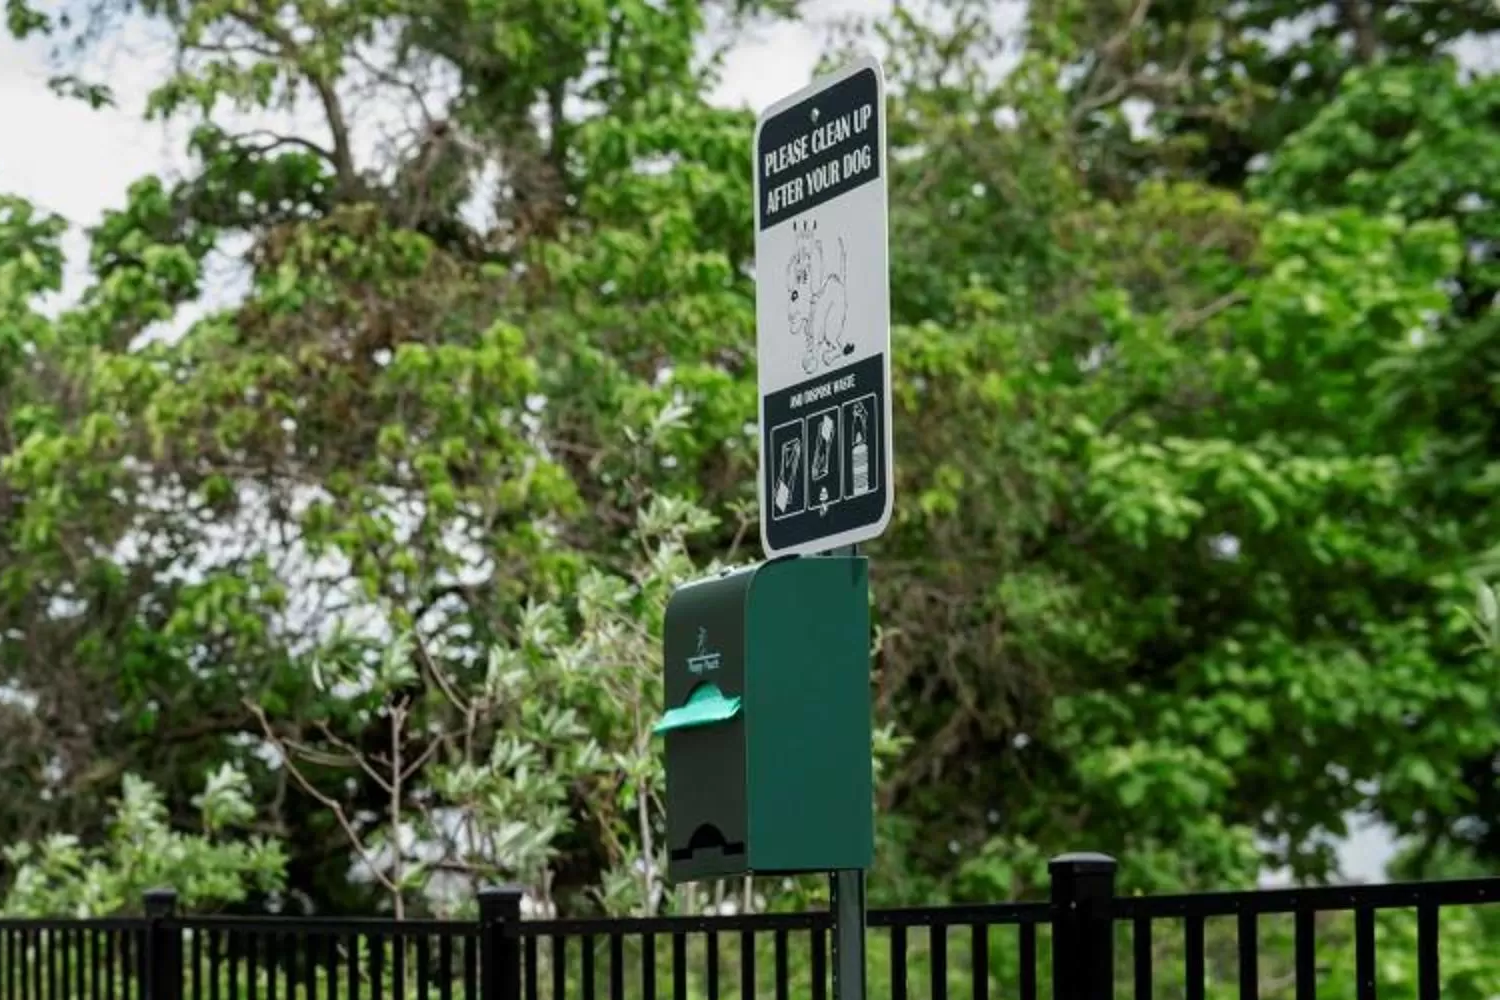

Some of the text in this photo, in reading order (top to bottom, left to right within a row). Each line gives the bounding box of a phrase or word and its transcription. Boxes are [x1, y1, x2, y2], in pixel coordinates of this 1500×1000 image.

[765, 104, 872, 177] PLEASE CLEAN UP
[766, 145, 871, 215] AFTER YOUR DOG
